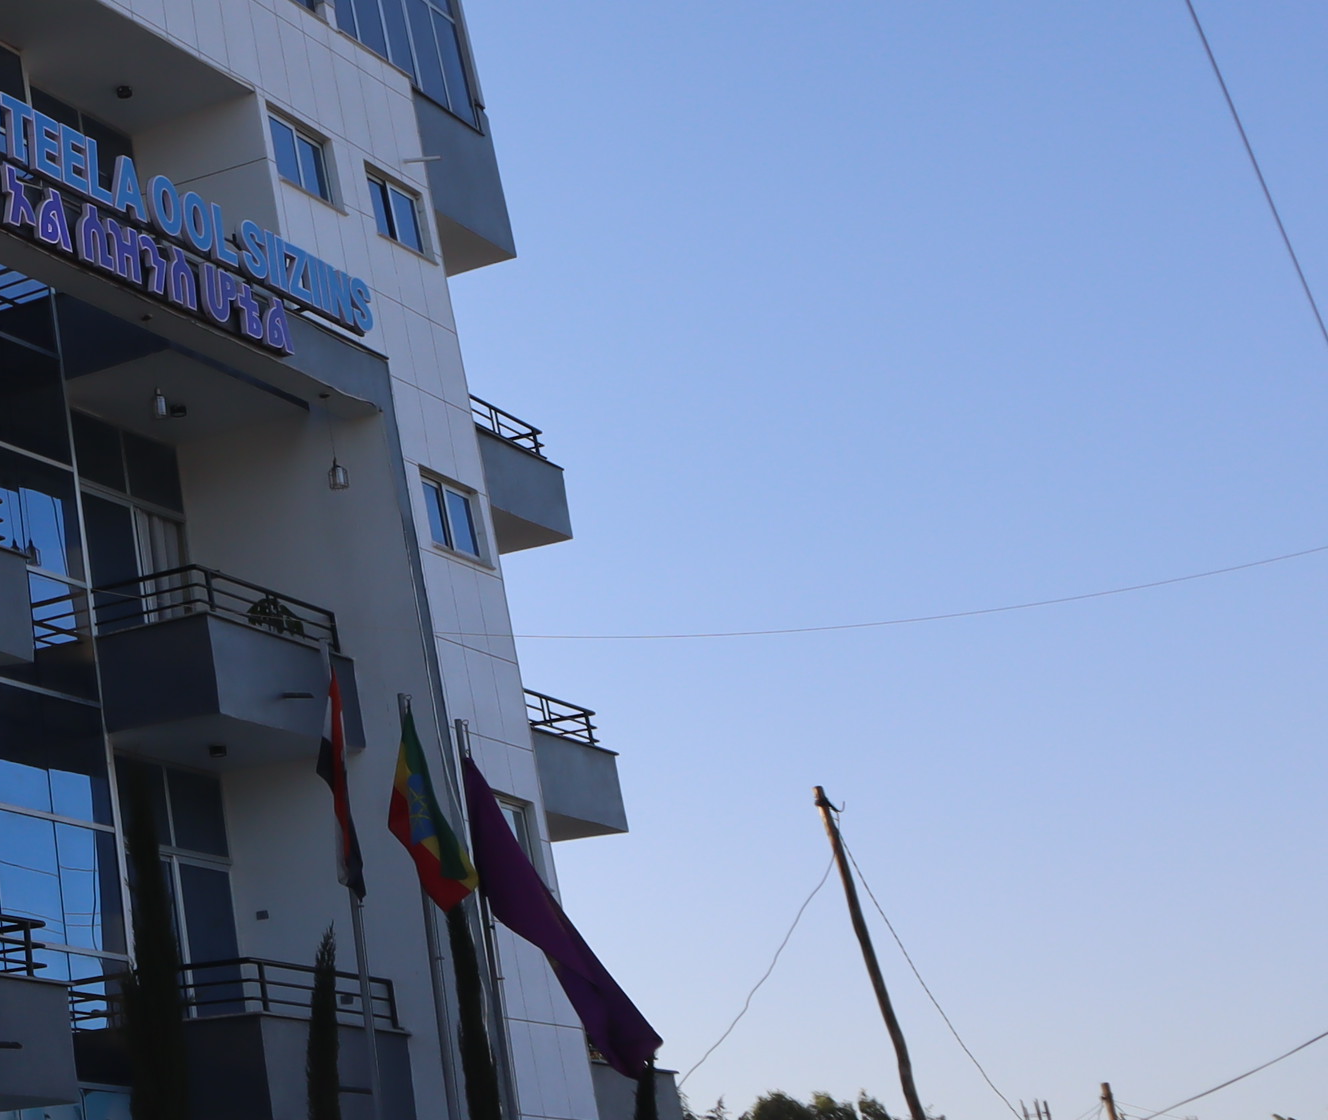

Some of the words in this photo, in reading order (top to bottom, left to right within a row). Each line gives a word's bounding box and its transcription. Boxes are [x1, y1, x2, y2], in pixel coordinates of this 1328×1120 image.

[147, 175, 239, 267] OOL
[238, 220, 374, 333] SIIZIINS
[199, 262, 294, 355] ሆቴል
